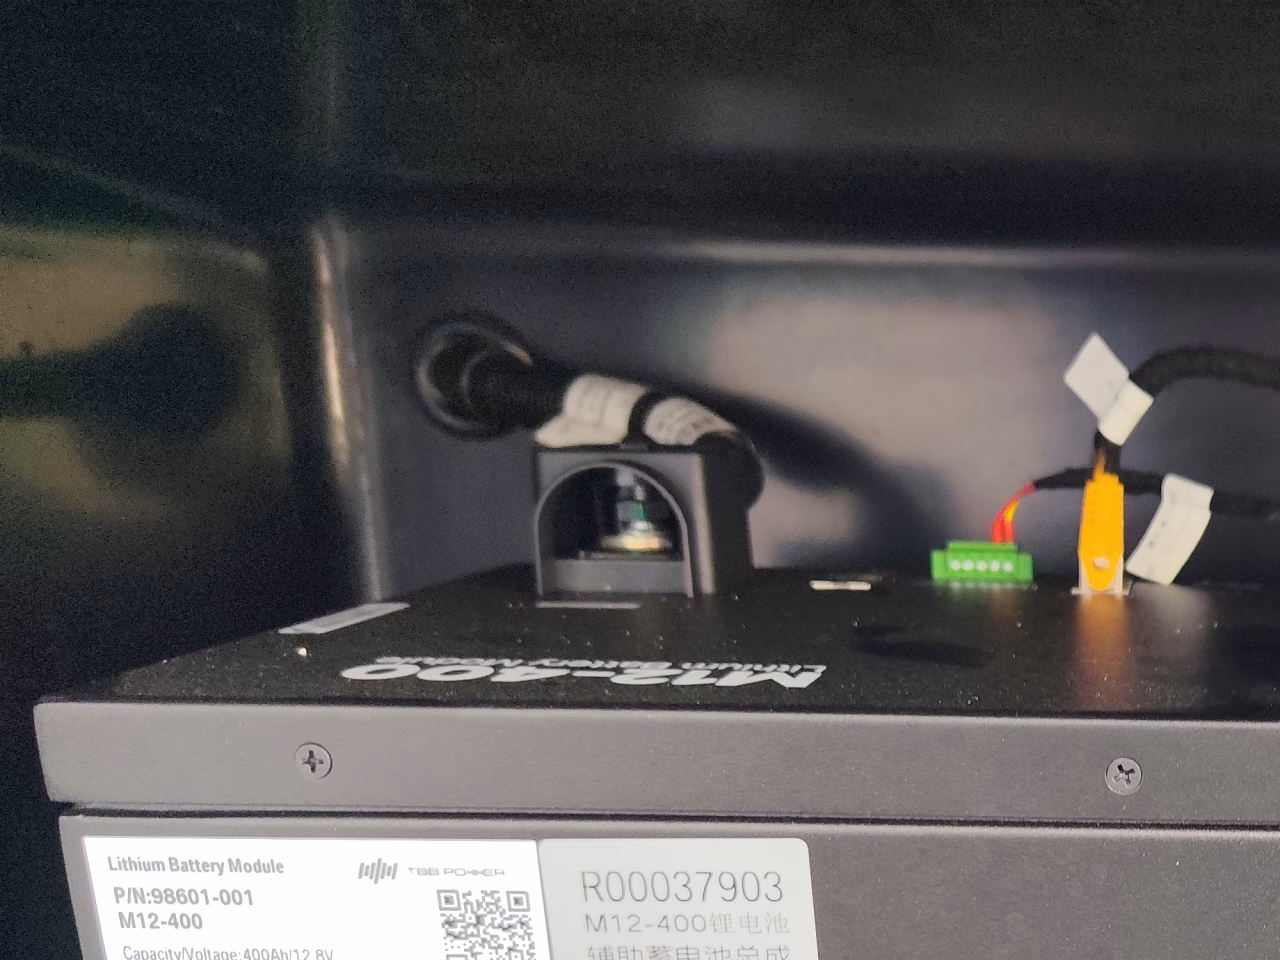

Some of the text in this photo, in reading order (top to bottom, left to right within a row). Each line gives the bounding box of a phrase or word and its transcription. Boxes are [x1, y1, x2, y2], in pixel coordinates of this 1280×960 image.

[341, 664, 823, 688] M12-400
[107, 855, 285, 877] Lithium Battery Module
[407, 866, 440, 877] TBB
[113, 886, 254, 906] P/N:98601-001
[581, 871, 784, 903] R00037903
[117, 911, 204, 930] M12-400
